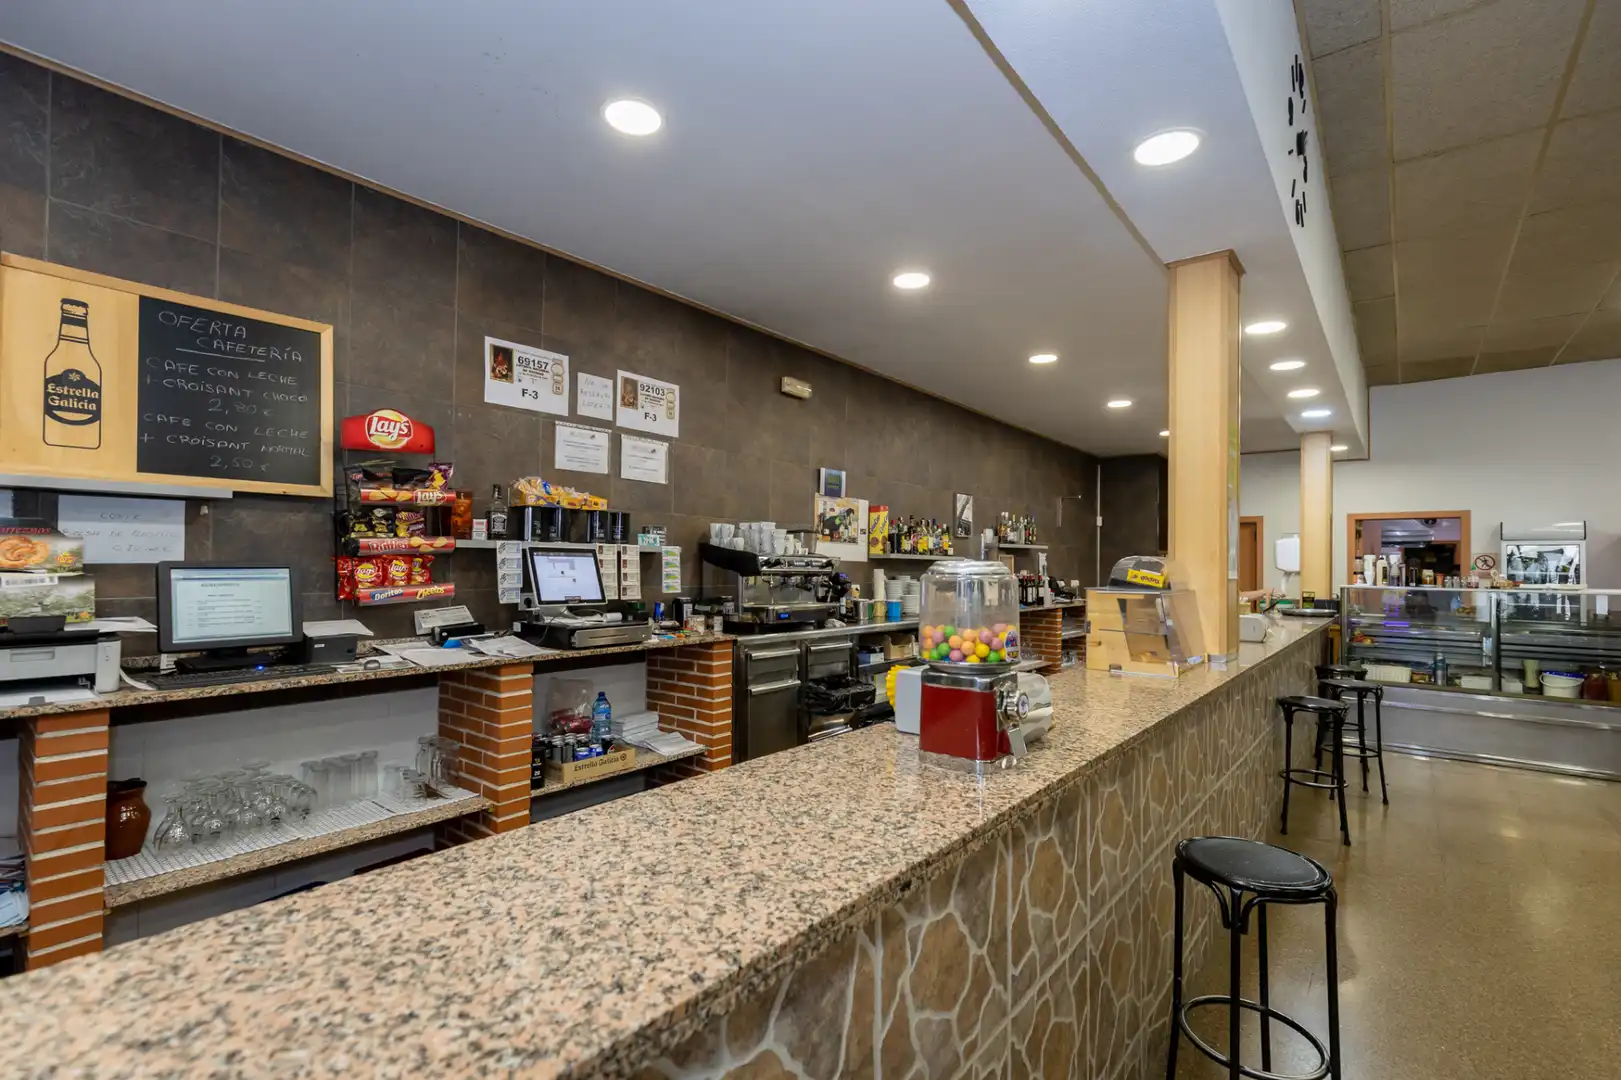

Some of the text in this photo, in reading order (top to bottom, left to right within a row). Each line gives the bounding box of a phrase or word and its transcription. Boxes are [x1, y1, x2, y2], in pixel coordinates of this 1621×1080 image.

[158, 310, 247, 339] OFERTA
[196, 336, 303, 363] CAFETERÍA
[146, 356, 298, 385] CAFE CON LECHE
[517, 355, 549, 371] 69157
[46, 383, 100, 399] Estrella
[521, 388, 540, 400] F-3
[639, 383, 665, 397] 92103
[48, 395, 97, 411] Galicia
[644, 411, 657, 422] F-3
[140, 433, 155, 443] +
[205, 421, 238, 433] CON
[254, 426, 309, 439] LECHE
[374, 588, 404, 601] Doritos
[574, 756, 619, 772] Estrella Galicia
